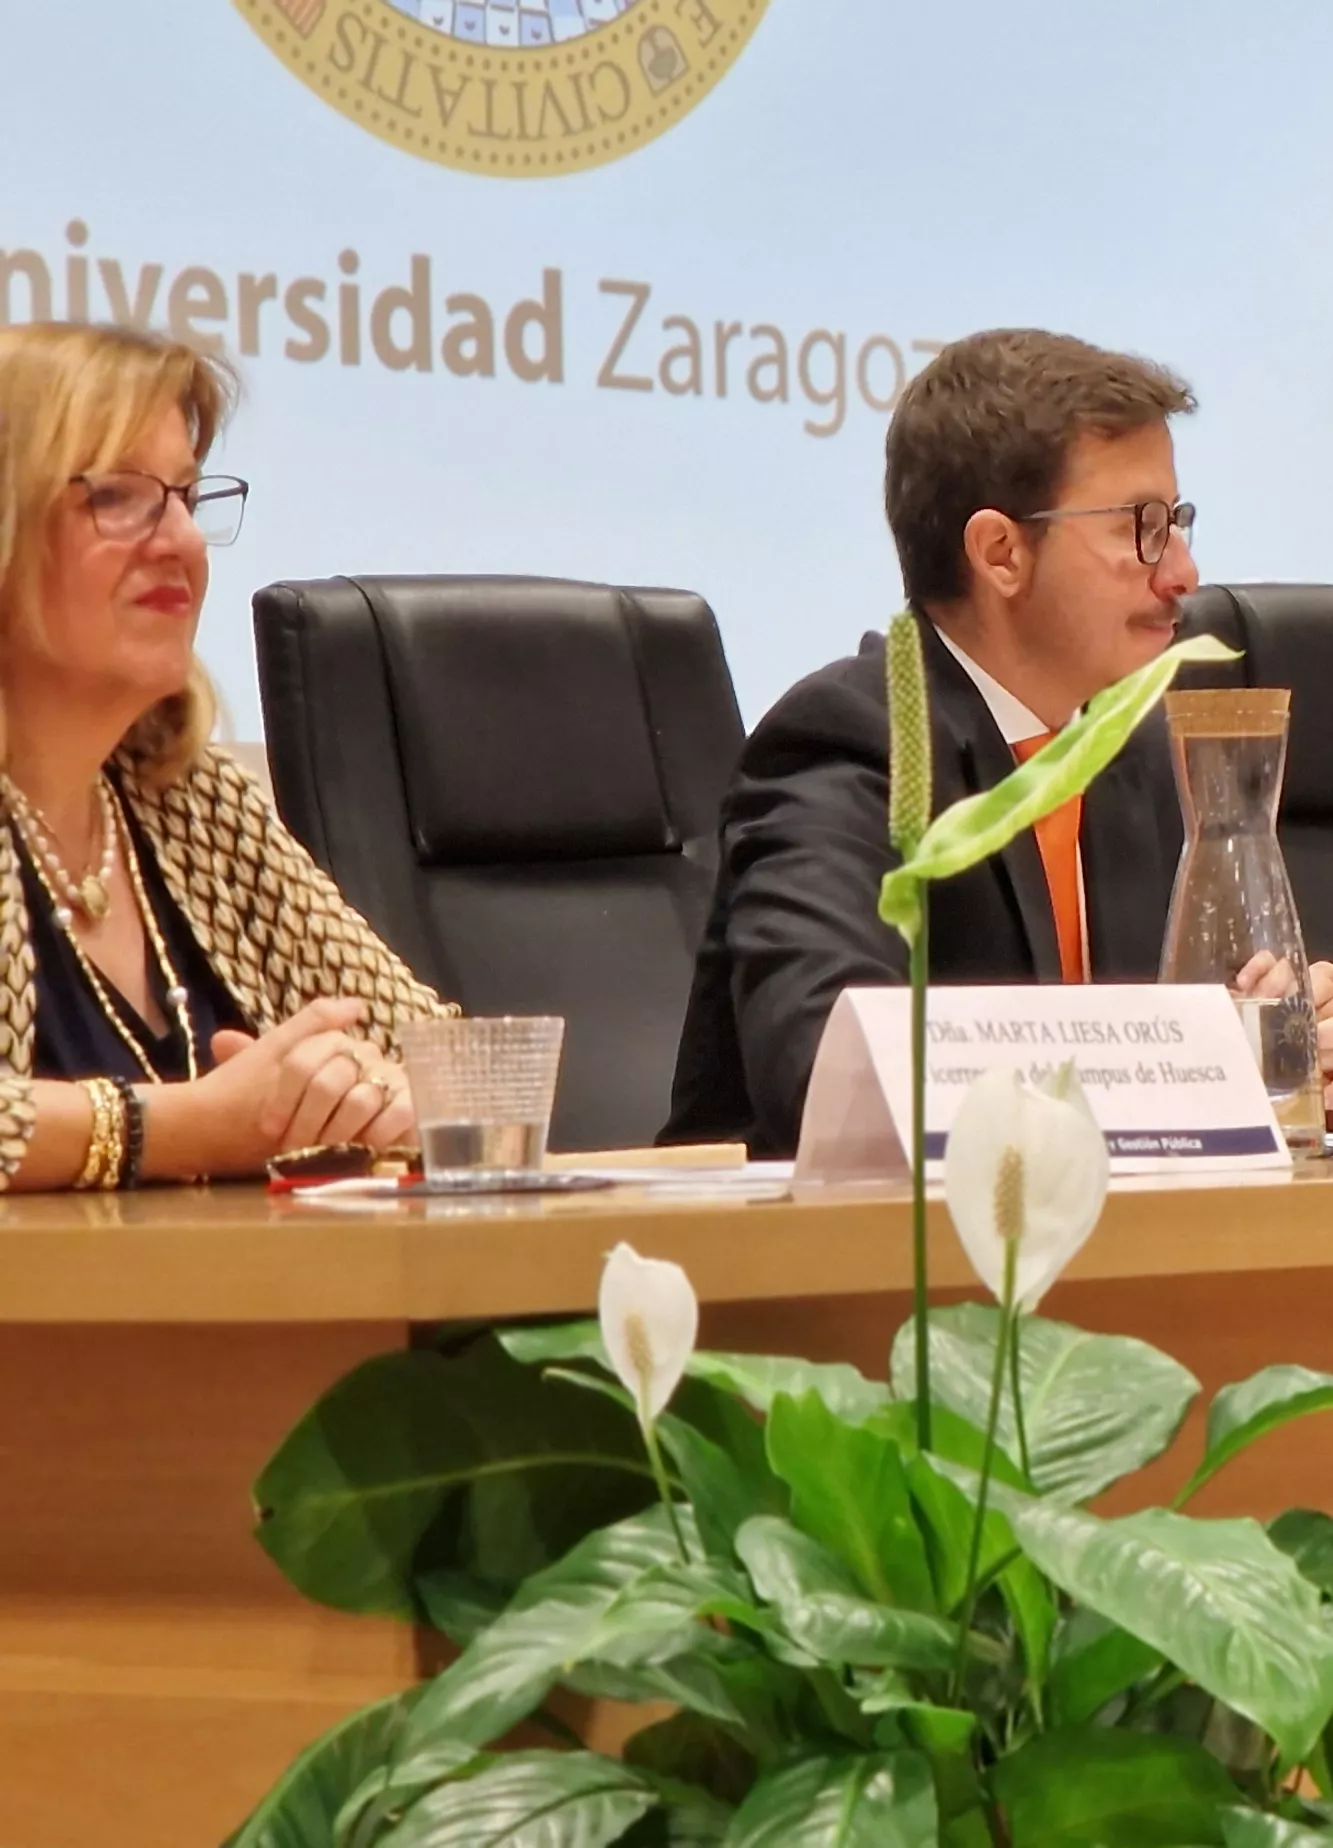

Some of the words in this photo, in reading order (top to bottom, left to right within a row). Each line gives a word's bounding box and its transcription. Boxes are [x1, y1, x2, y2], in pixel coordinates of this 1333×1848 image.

[328, 9, 632, 142] CIVITATIS
[0, 217, 563, 384] niversidad
[596, 277, 950, 438] Zarago
[926, 1019, 973, 1045] Dña.
[974, 1020, 1056, 1044] MARTA
[1057, 1019, 1121, 1044] LIESA
[1123, 1015, 1184, 1044] ORÚS
[1076, 1064, 1131, 1091] ampus
[1135, 1061, 1156, 1084] de
[1158, 1061, 1227, 1084] Huesca
[1117, 1136, 1160, 1152] Gestión
[1160, 1136, 1203, 1150] Pública
